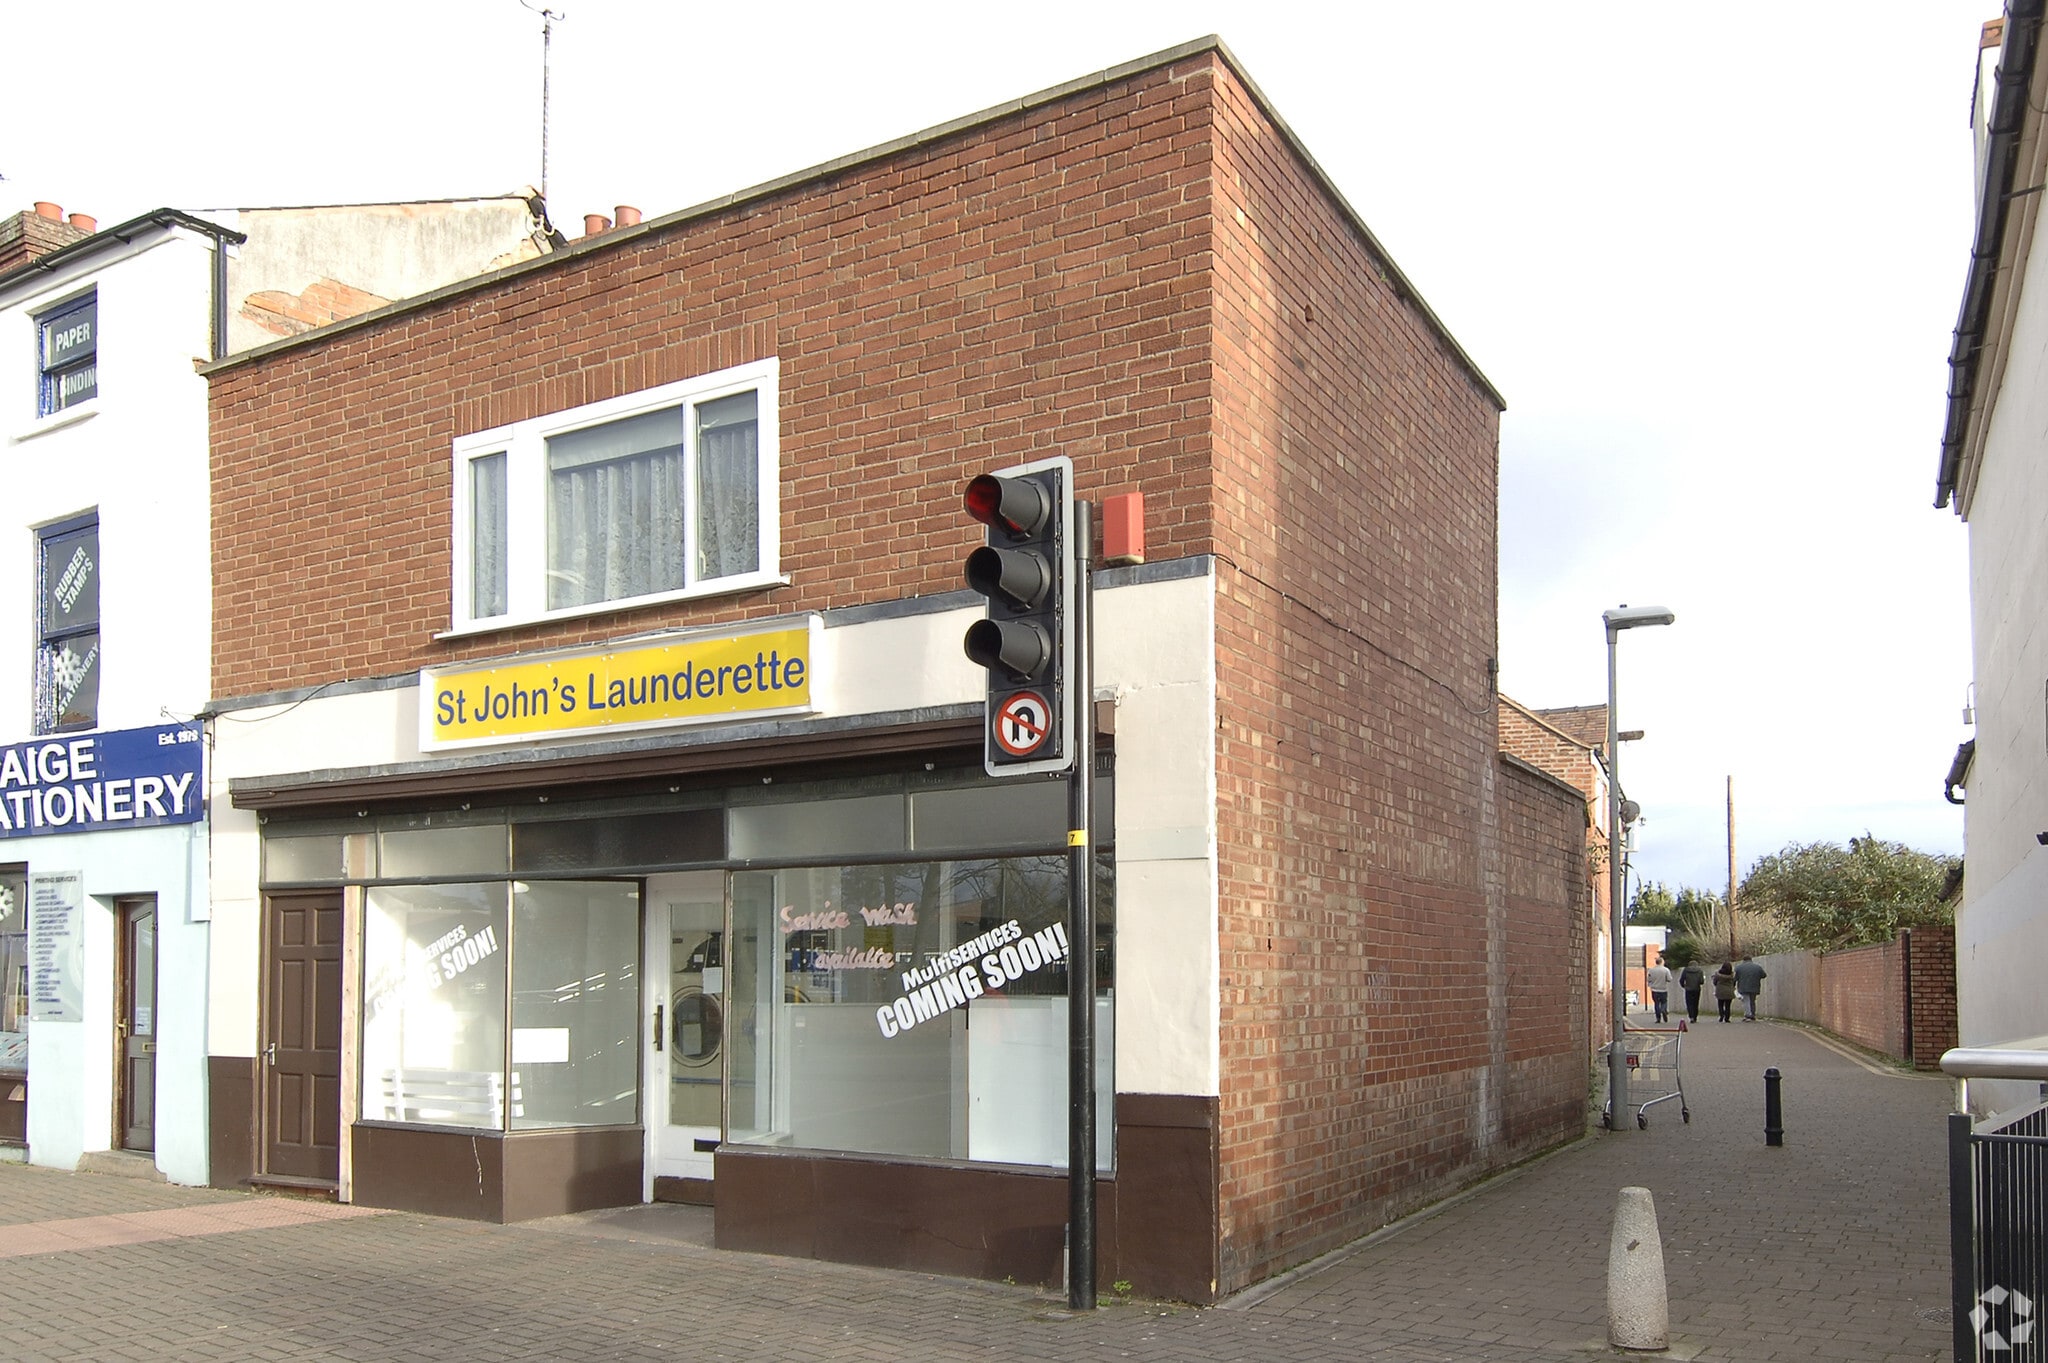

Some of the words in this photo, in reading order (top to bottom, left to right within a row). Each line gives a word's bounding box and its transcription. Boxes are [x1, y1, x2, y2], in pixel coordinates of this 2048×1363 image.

[56, 322, 90, 352] PAPER
[54, 546, 86, 602] RUBBER
[62, 557, 93, 614] STAMPS
[58, 642, 99, 716] STATIONERY
[436, 688, 467, 726] St
[474, 677, 576, 723] John's
[588, 650, 805, 710] Launderette
[0, 738, 97, 789] AIGE
[158, 732, 176, 746] Est.
[1070, 833, 1075, 843] 7
[440, 925, 498, 980] SOON!
[876, 965, 984, 1039] COMING
[981, 921, 1069, 989] SOON!
